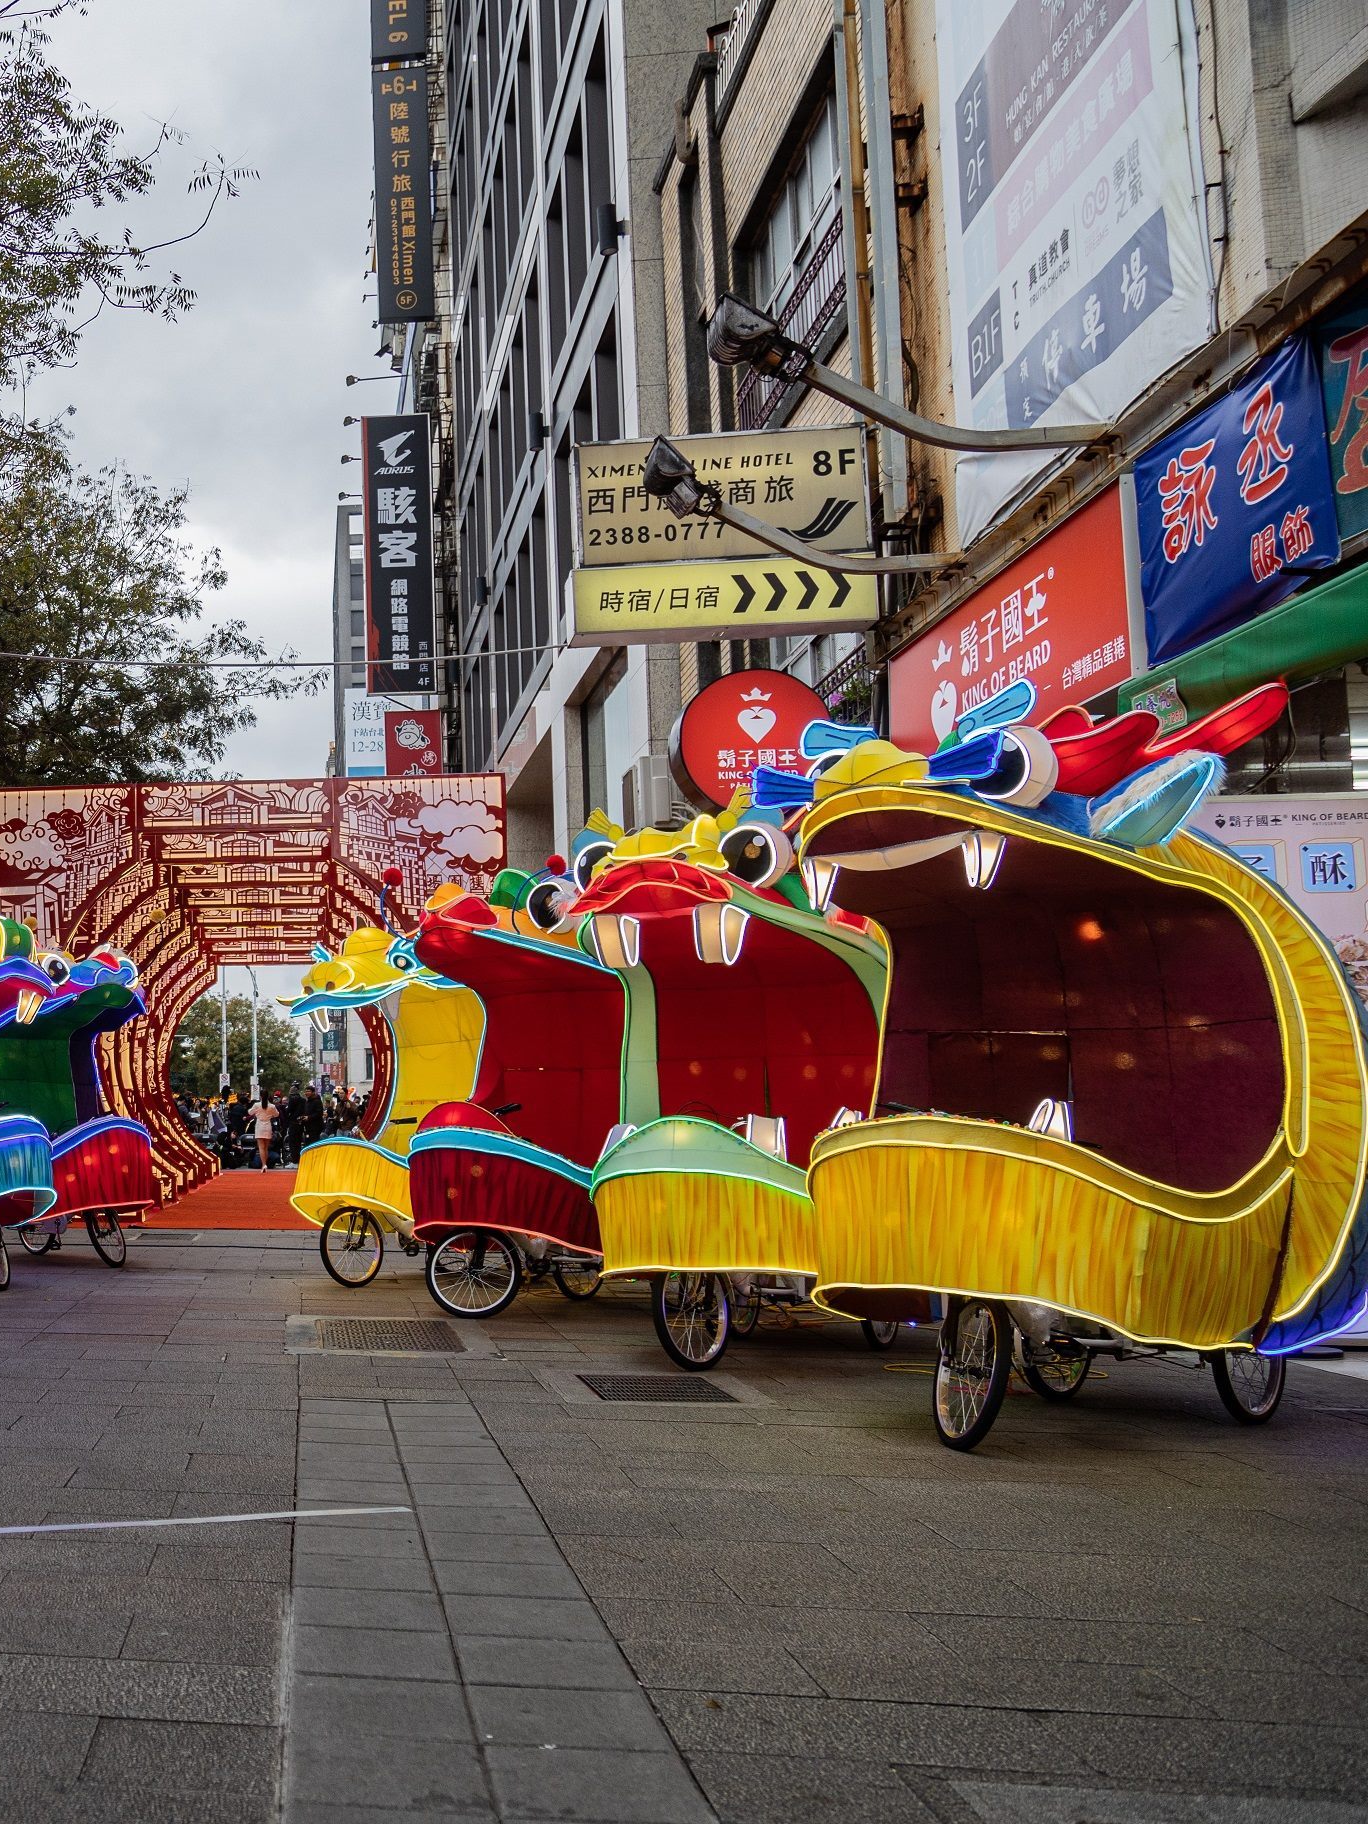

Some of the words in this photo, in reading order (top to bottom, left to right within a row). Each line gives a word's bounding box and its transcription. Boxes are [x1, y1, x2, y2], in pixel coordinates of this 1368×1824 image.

[964, 80, 982, 143] 3F
[1005, 86, 1028, 128] HUNG
[1031, 55, 1049, 92] KAN
[390, 102, 411, 192] 陸號行旅
[966, 140, 986, 203] 2F
[401, 197, 416, 238] 西門館
[403, 241, 416, 285] Ximen
[400, 296, 413, 305] 5F
[1042, 247, 1148, 391] 停車場
[971, 309, 1000, 379] B1F
[374, 466, 415, 475] AORUS
[740, 452, 793, 469] HOTEL
[812, 448, 856, 476] 8F
[377, 486, 419, 568] 駭客
[588, 521, 726, 546] 2388-0777
[1250, 504, 1314, 583] 服飾
[599, 585, 720, 614] 時宿/日宿
[390, 579, 410, 670] 網路電競館
[959, 573, 1049, 677] 鬍子國王
[418, 677, 430, 686] 4F
[961, 676, 988, 712] KING
[990, 667, 1006, 694] OF
[1009, 639, 1051, 684] BEARD
[1062, 635, 1126, 690] 台灣精品蛋捲
[352, 740, 384, 753] 12-28
[717, 749, 798, 768] 鬍子國王
[718, 771, 744, 780] KING
[1229, 814, 1282, 828] 鬍子國王
[1320, 813, 1334, 821] OF
[1336, 812, 1368, 821] BEARD
[1309, 852, 1348, 885] 酥
